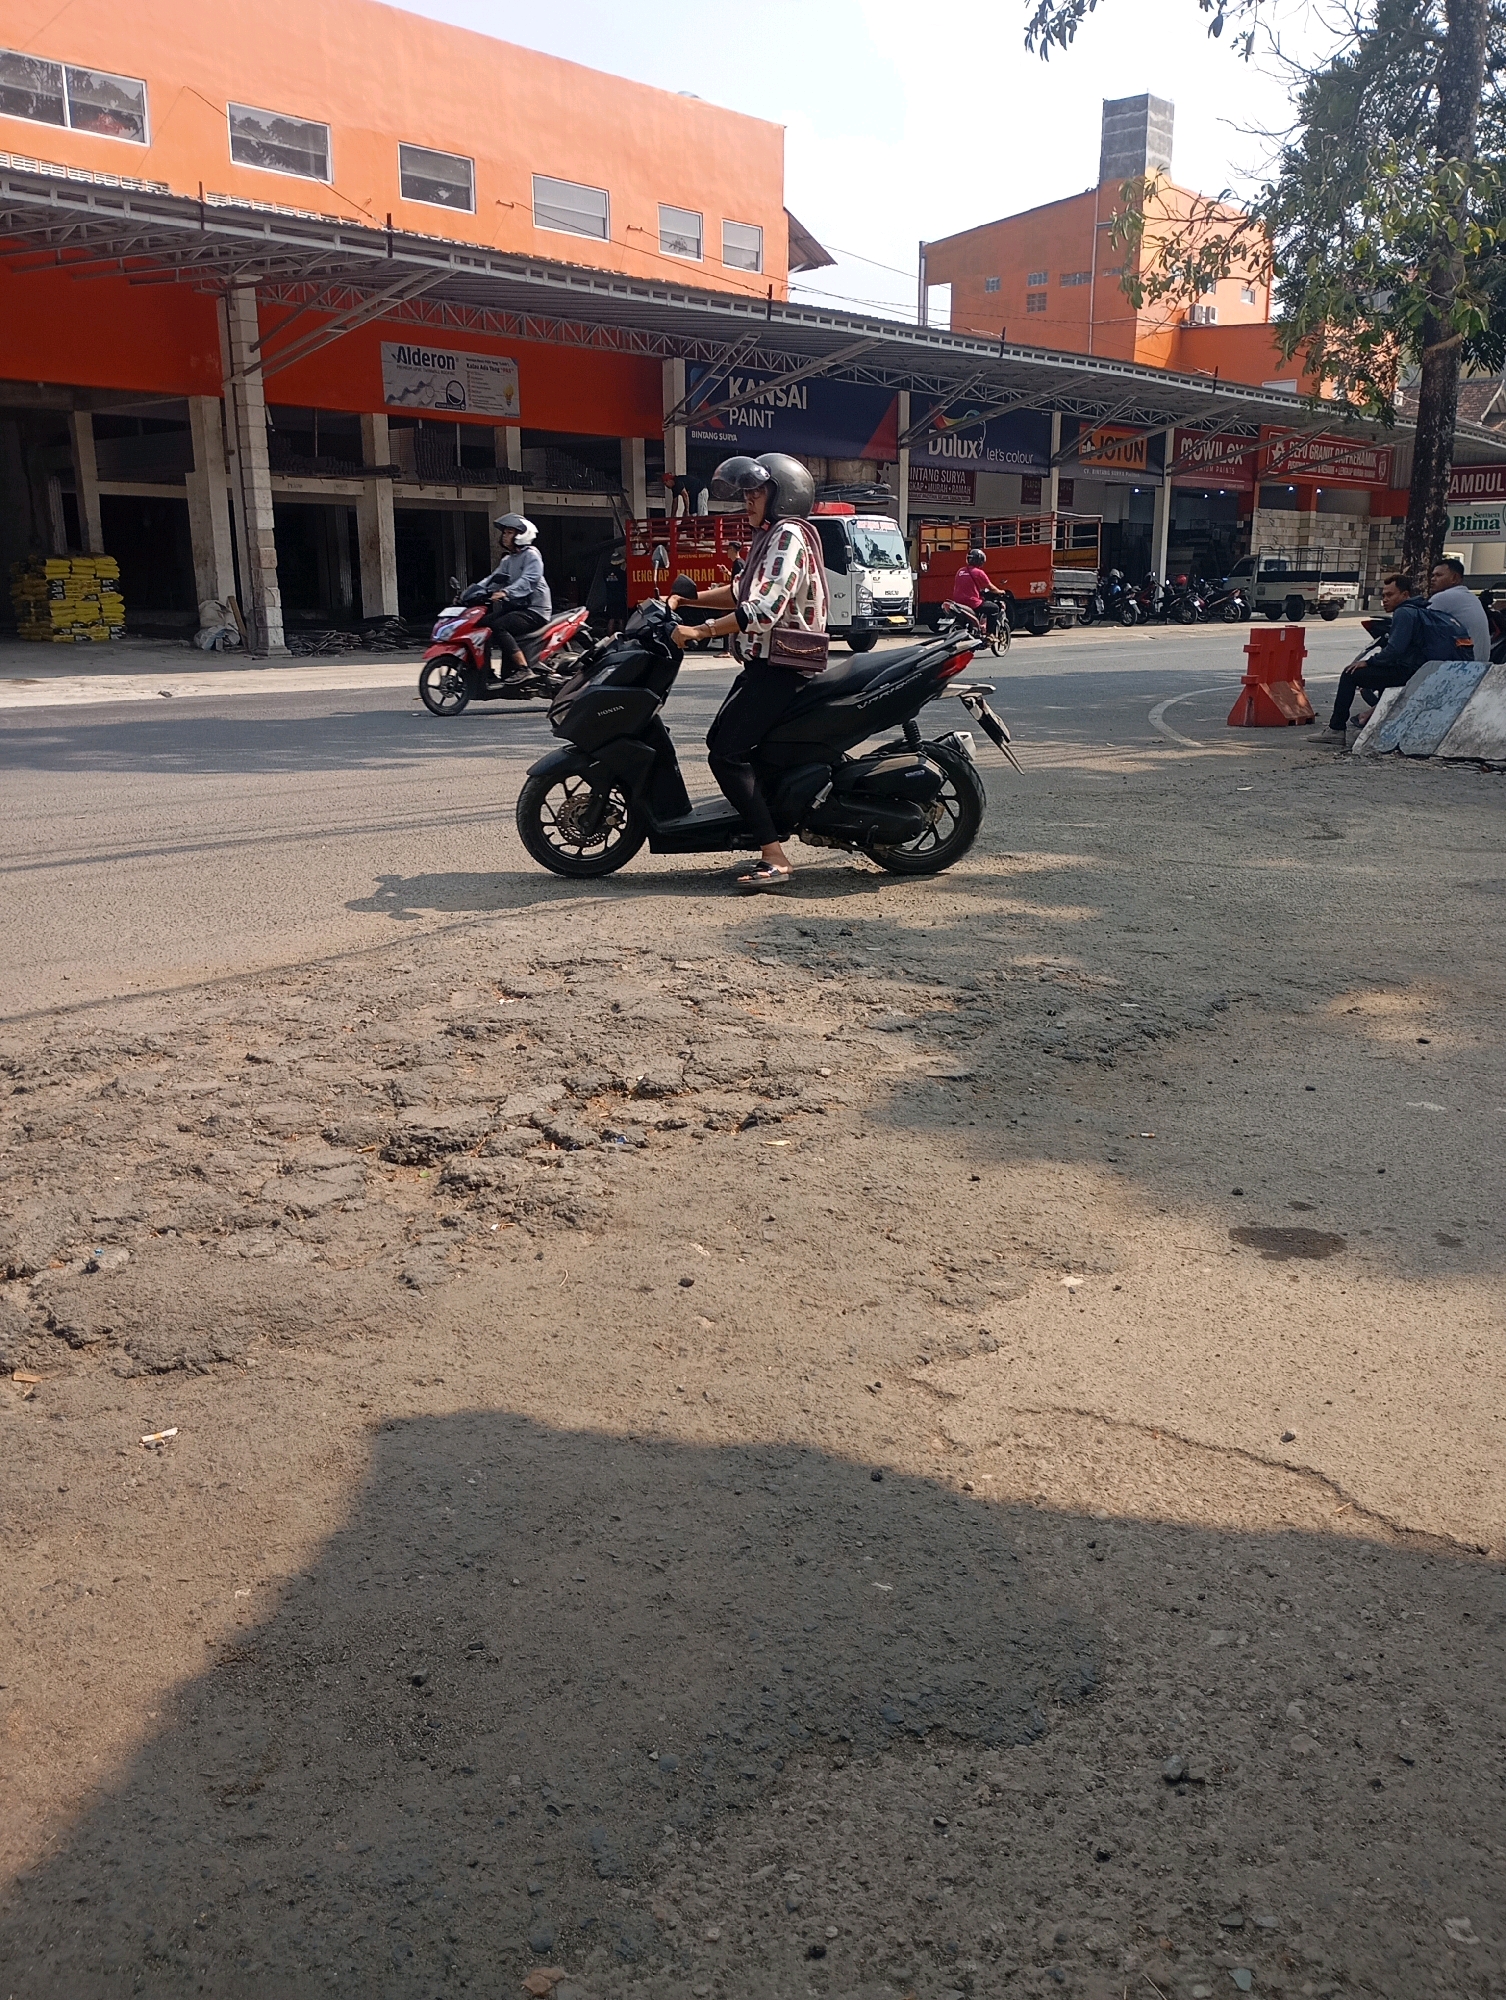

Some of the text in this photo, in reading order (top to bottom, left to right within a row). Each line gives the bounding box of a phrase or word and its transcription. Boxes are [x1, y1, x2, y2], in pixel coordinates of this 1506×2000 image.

[391, 345, 455, 370] Alderon
[728, 375, 807, 410] KANSAI
[729, 407, 775, 429] PAINT
[691, 430, 738, 442] BINTANG SURYA
[928, 428, 979, 459] Dulux
[986, 447, 1034, 464] let's colour
[1097, 435, 1144, 463] JOTUN
[910, 466, 966, 484] INTANG SURYA
[1452, 516, 1500, 530] Bima
[632, 569, 670, 582] LENGAP
[597, 706, 624, 716] HONDA
